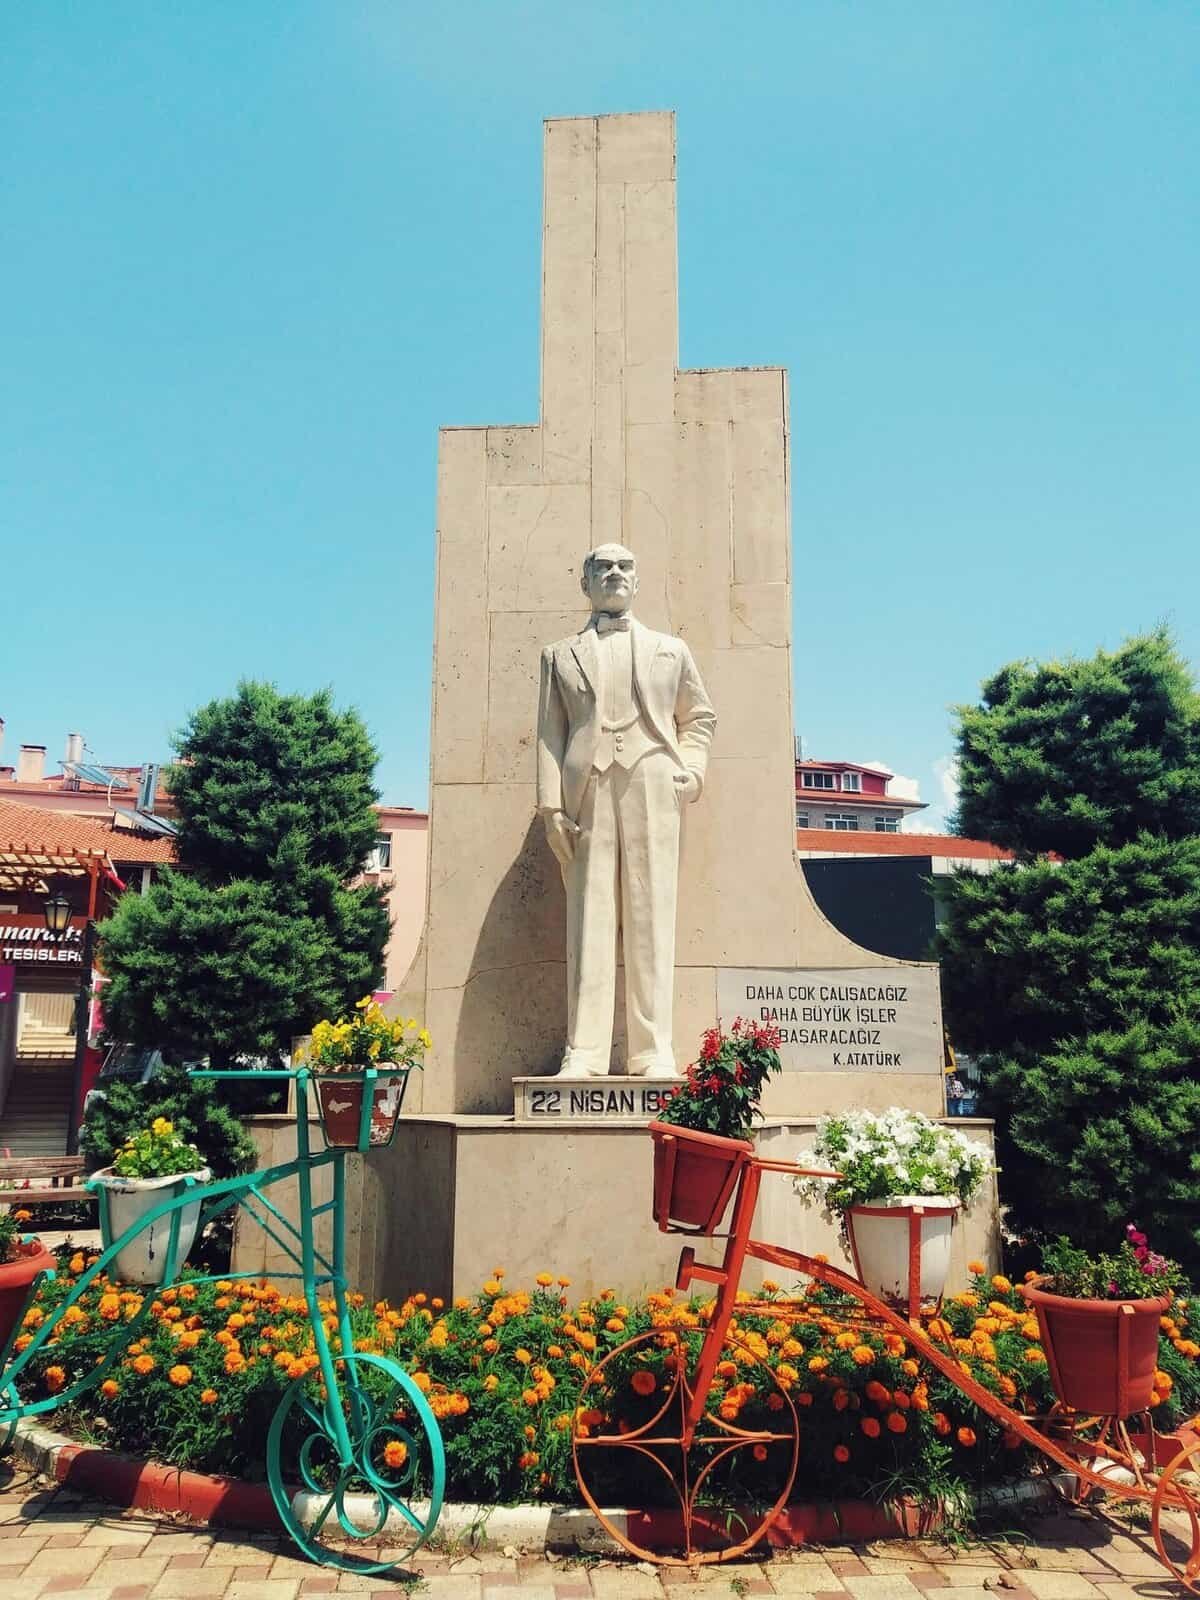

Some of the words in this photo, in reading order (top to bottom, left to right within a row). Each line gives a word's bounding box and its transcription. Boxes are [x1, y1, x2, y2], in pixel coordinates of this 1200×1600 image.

[746, 985, 784, 1001] DAHA
[788, 986, 816, 1002] ÇOK
[819, 985, 908, 1003] ÇALIŞACAĞIZ
[760, 1006, 798, 1022] DAHA
[802, 1005, 852, 1023] BÜYÜK
[856, 1006, 897, 1024] İŞLER
[833, 1050, 902, 1066] K.ATATÜRK
[531, 1090, 561, 1113] 22
